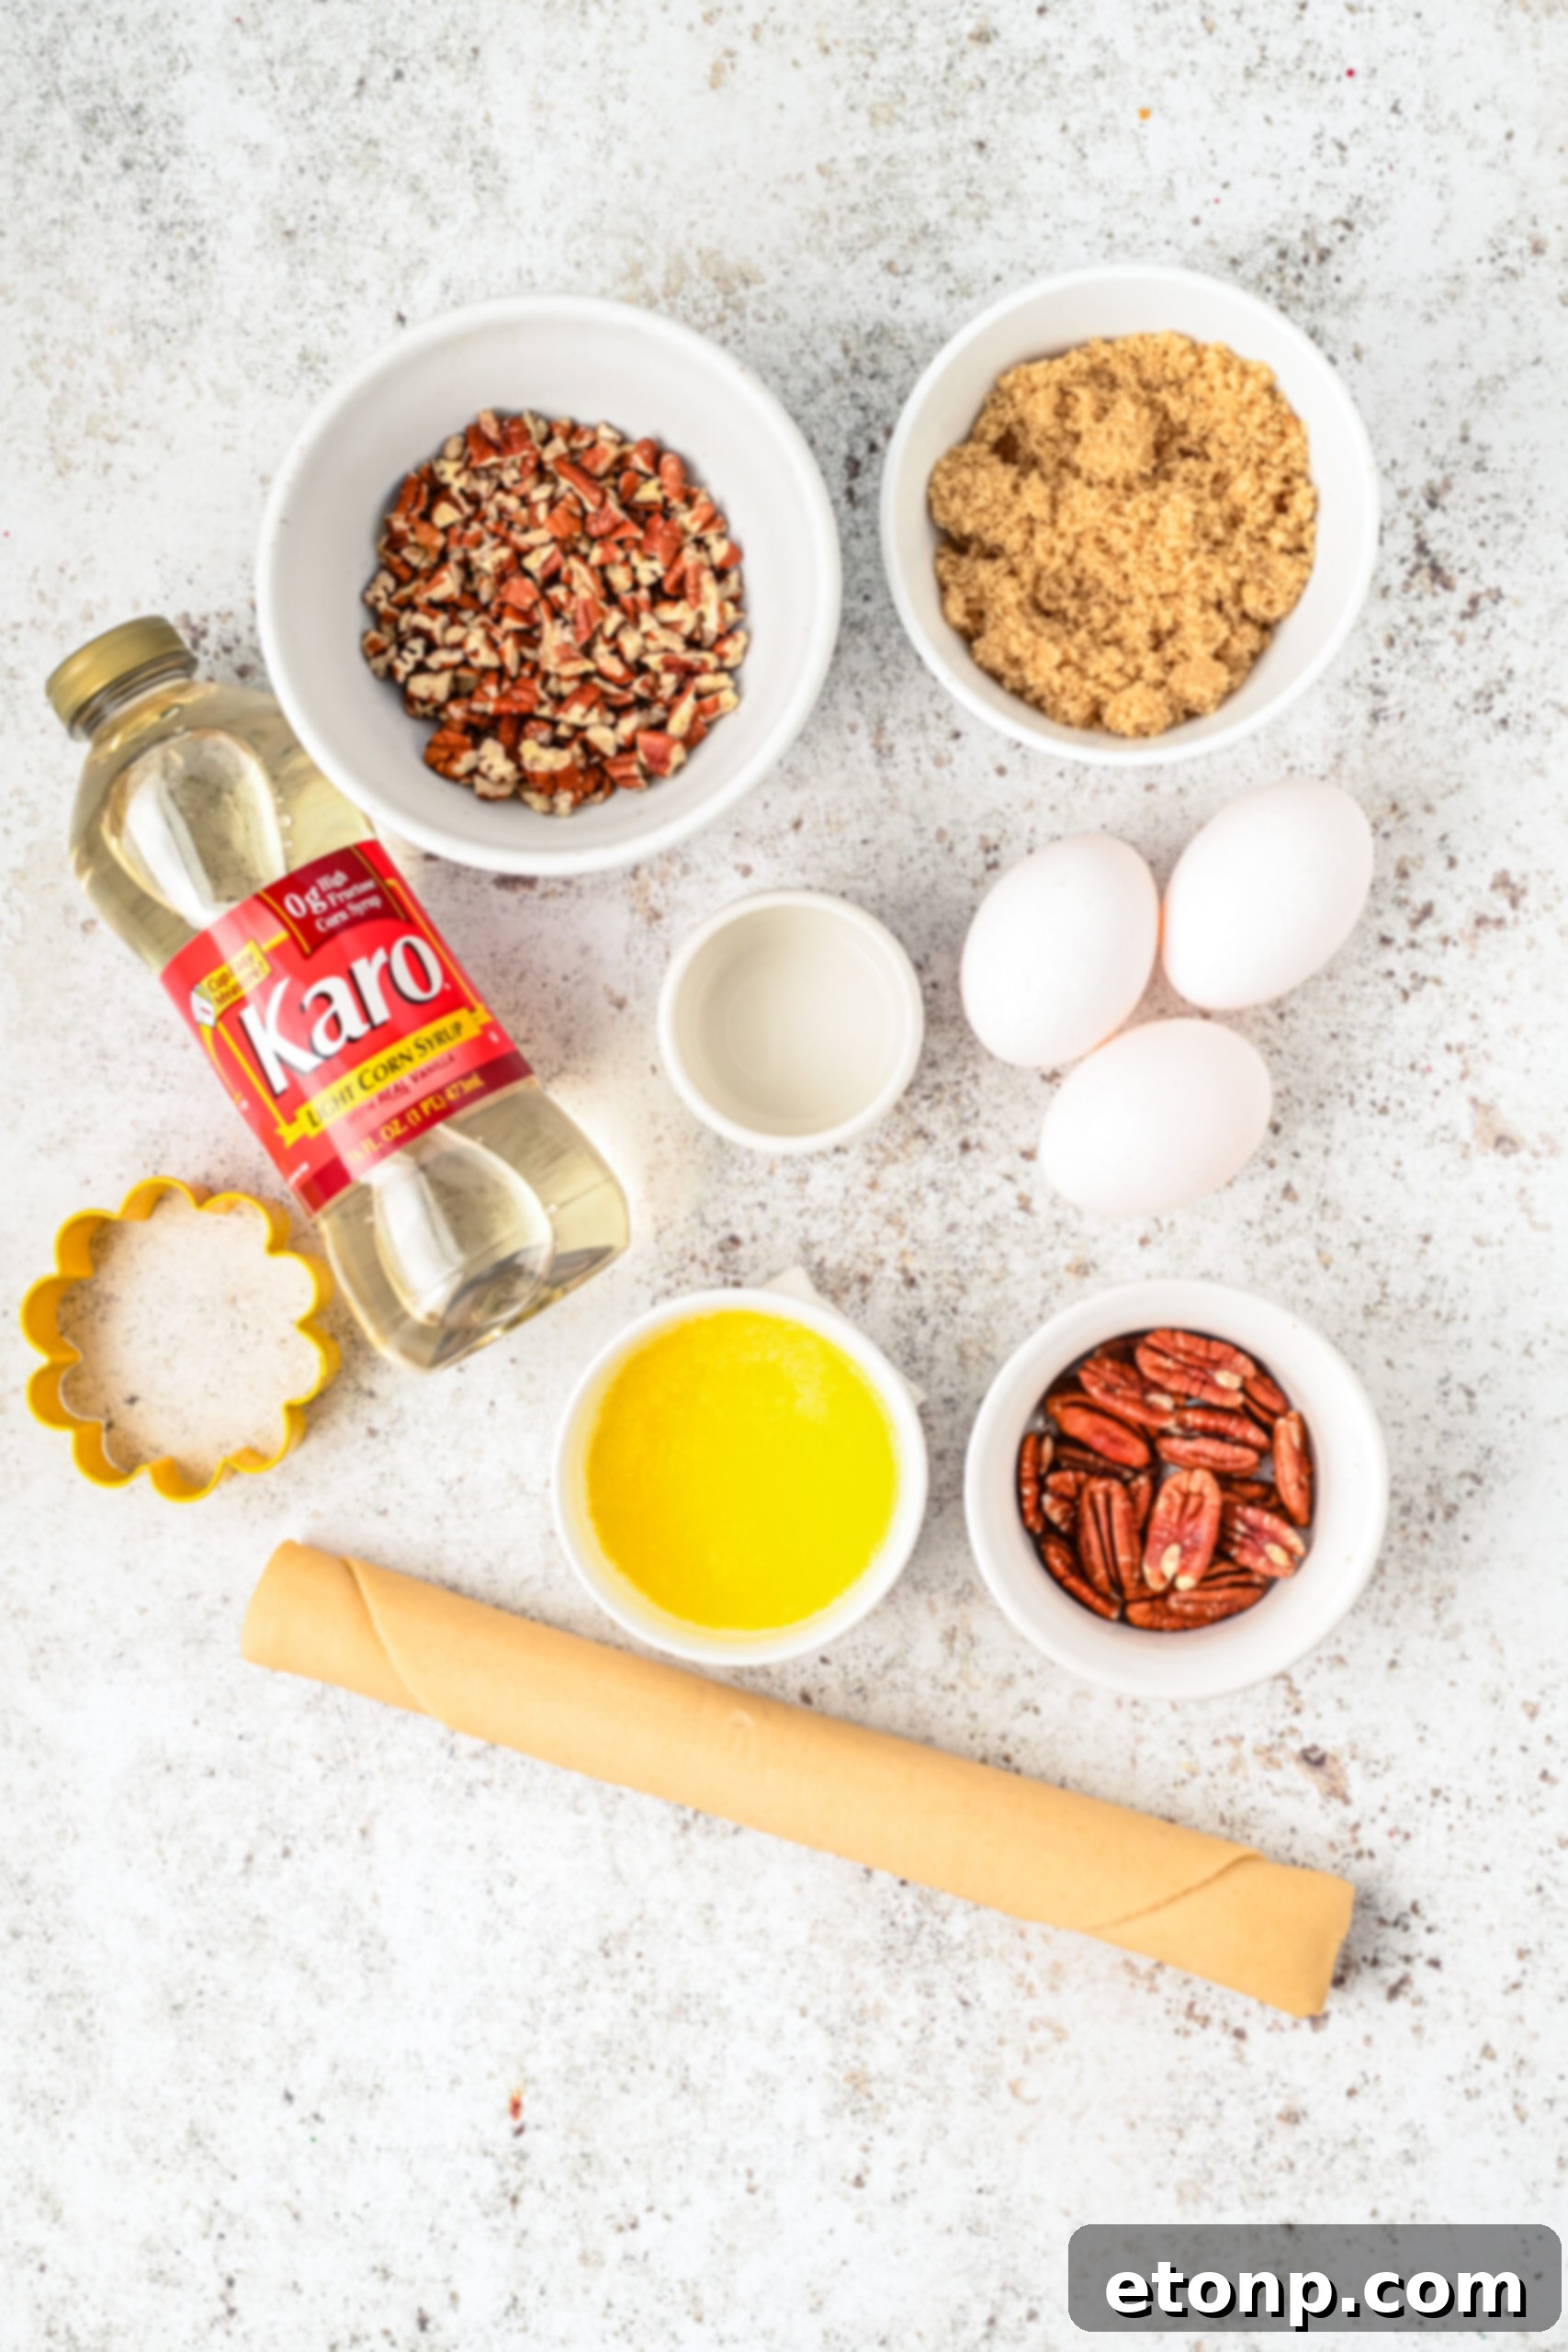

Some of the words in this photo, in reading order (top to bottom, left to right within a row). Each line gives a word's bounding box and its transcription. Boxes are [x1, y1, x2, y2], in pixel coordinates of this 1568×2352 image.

[284, 887, 327, 918] 0g
[237, 937, 444, 1098] Karo
[306, 1084, 355, 1128] LIGHT
[357, 1049, 413, 1091] CORN
[413, 1021, 463, 1057] SYRUP
[377, 1079, 411, 1104] REAL
[411, 1054, 455, 1083] VANILLA
